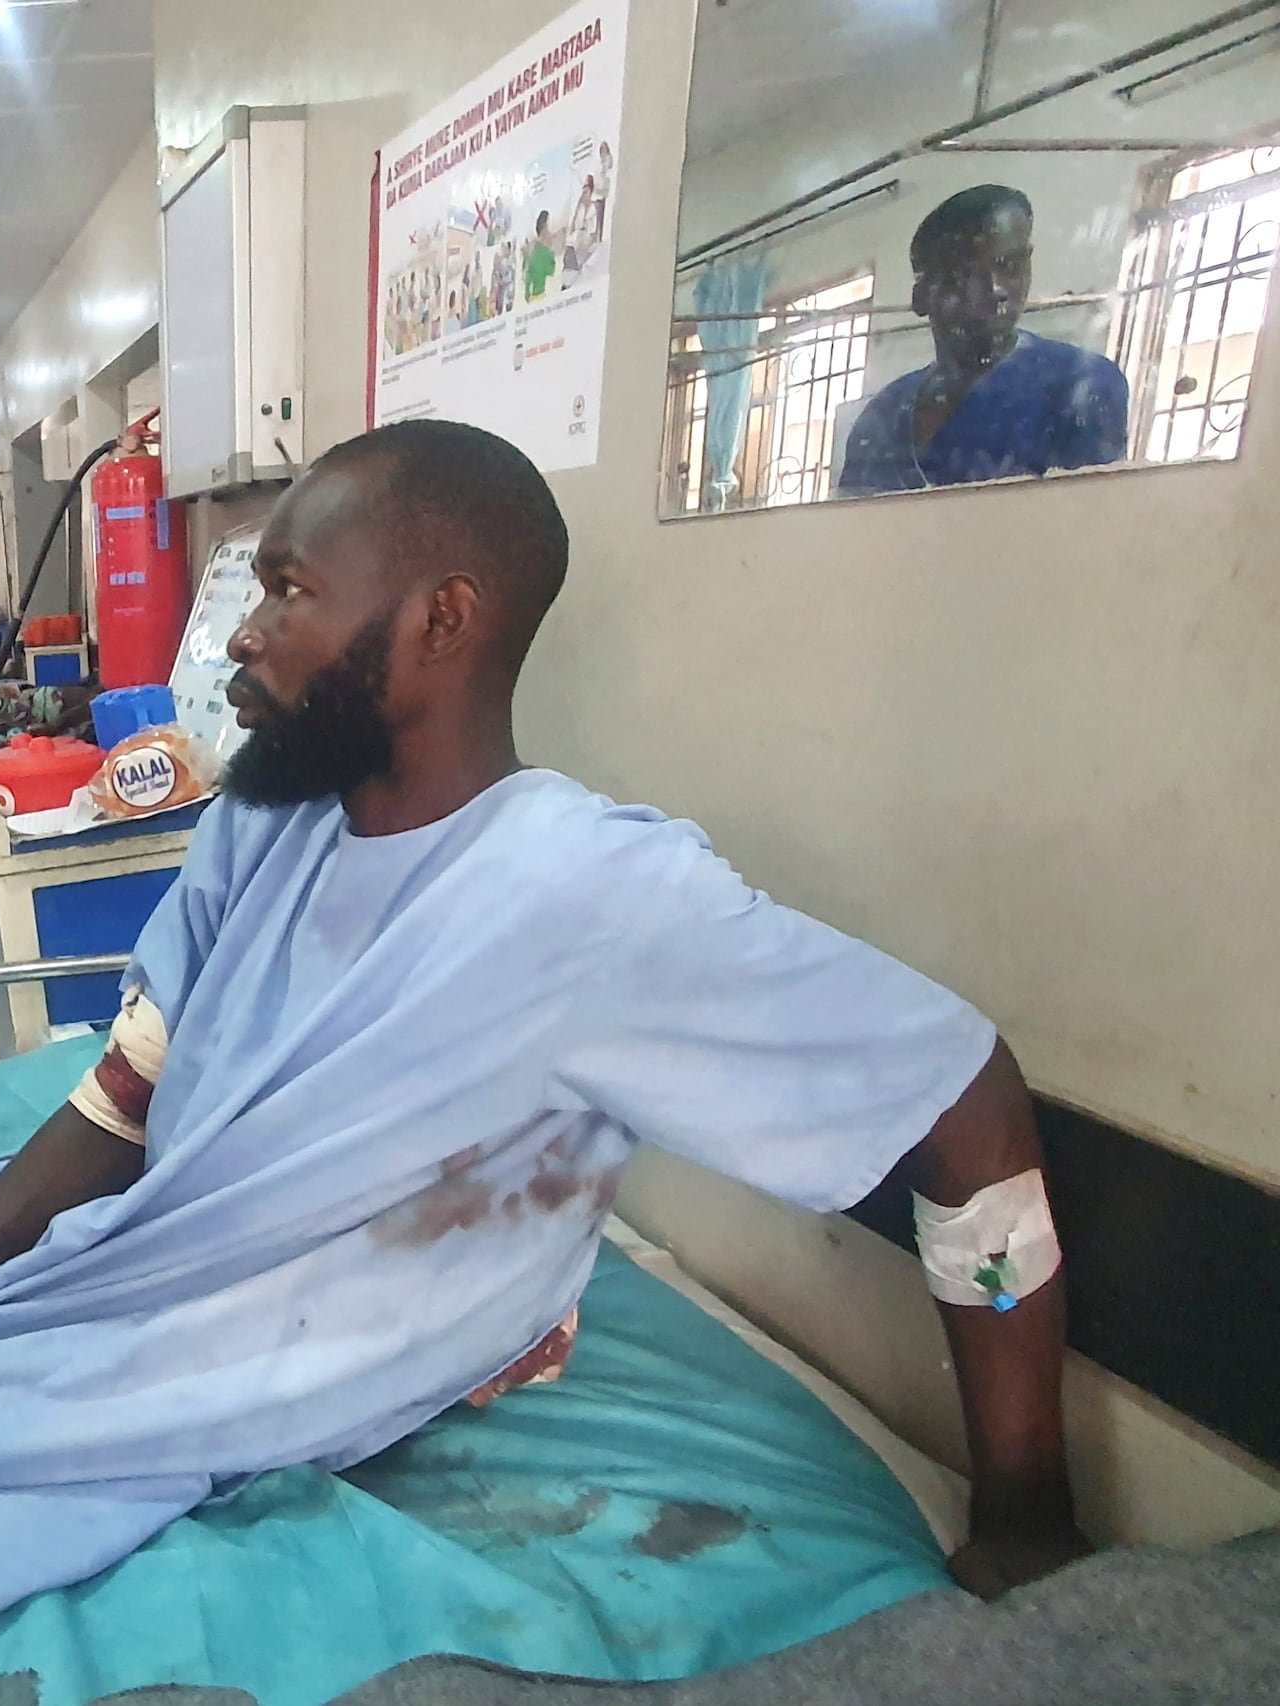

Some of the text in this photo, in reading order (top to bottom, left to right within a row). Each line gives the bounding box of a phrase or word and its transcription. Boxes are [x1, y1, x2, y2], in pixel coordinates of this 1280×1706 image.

[387, 167, 393, 187] A
[453, 100, 485, 141] DOMIN
[487, 86, 505, 118] MU
[508, 61, 538, 103] KARE
[541, 17, 602, 81] MARTABA
[387, 187, 396, 211] DA
[469, 129, 484, 157] KU
[485, 124, 493, 147] A
[495, 100, 526, 140] YAYIN
[528, 77, 560, 119] AIKIN
[563, 60, 585, 97] MU
[116, 756, 172, 789] KALAL
